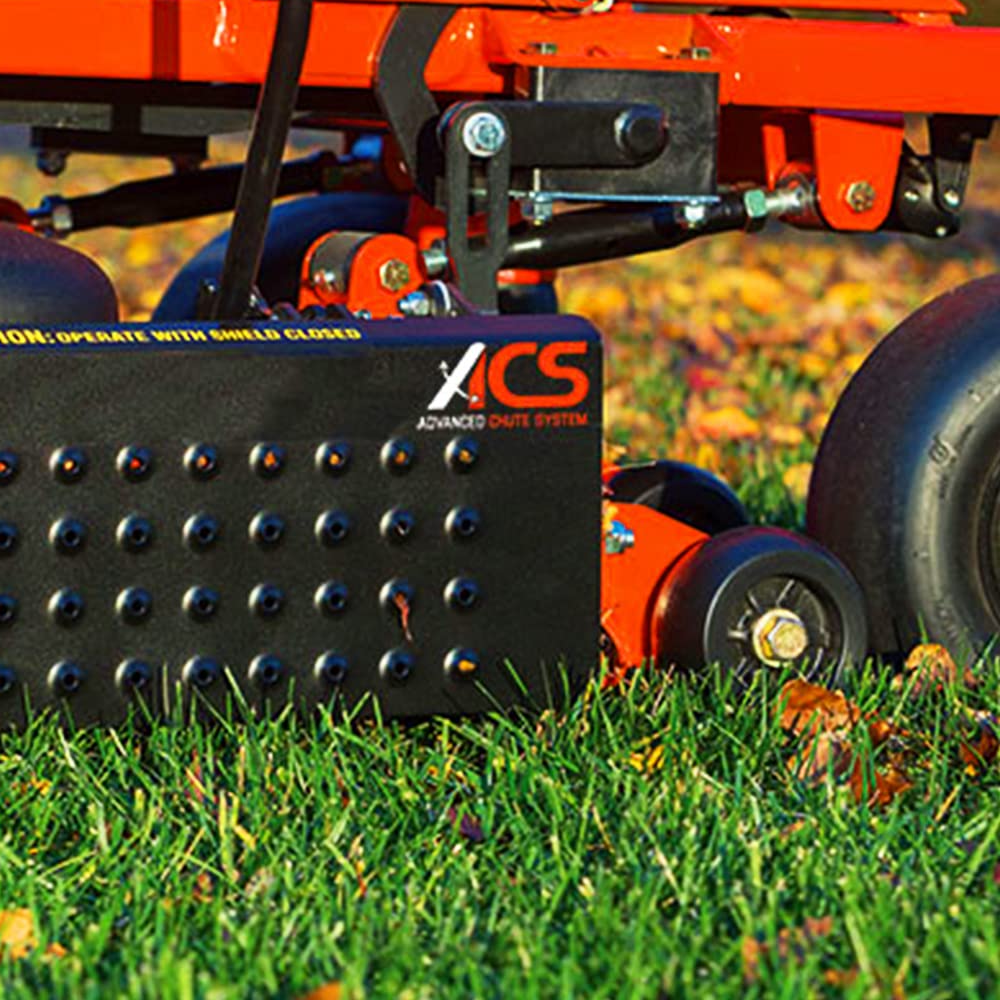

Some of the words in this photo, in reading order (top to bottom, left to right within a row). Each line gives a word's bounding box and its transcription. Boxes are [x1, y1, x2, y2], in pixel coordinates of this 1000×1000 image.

[58, 330, 149, 343] OPERATE
[151, 329, 206, 343] WITH
[210, 328, 281, 341] SHIELD
[283, 327, 362, 341] CLOSED
[427, 340, 590, 410] ACS
[416, 415, 486, 430] ADVANCED
[488, 414, 530, 428] CHUTE
[534, 413, 588, 426] SYSTEM
